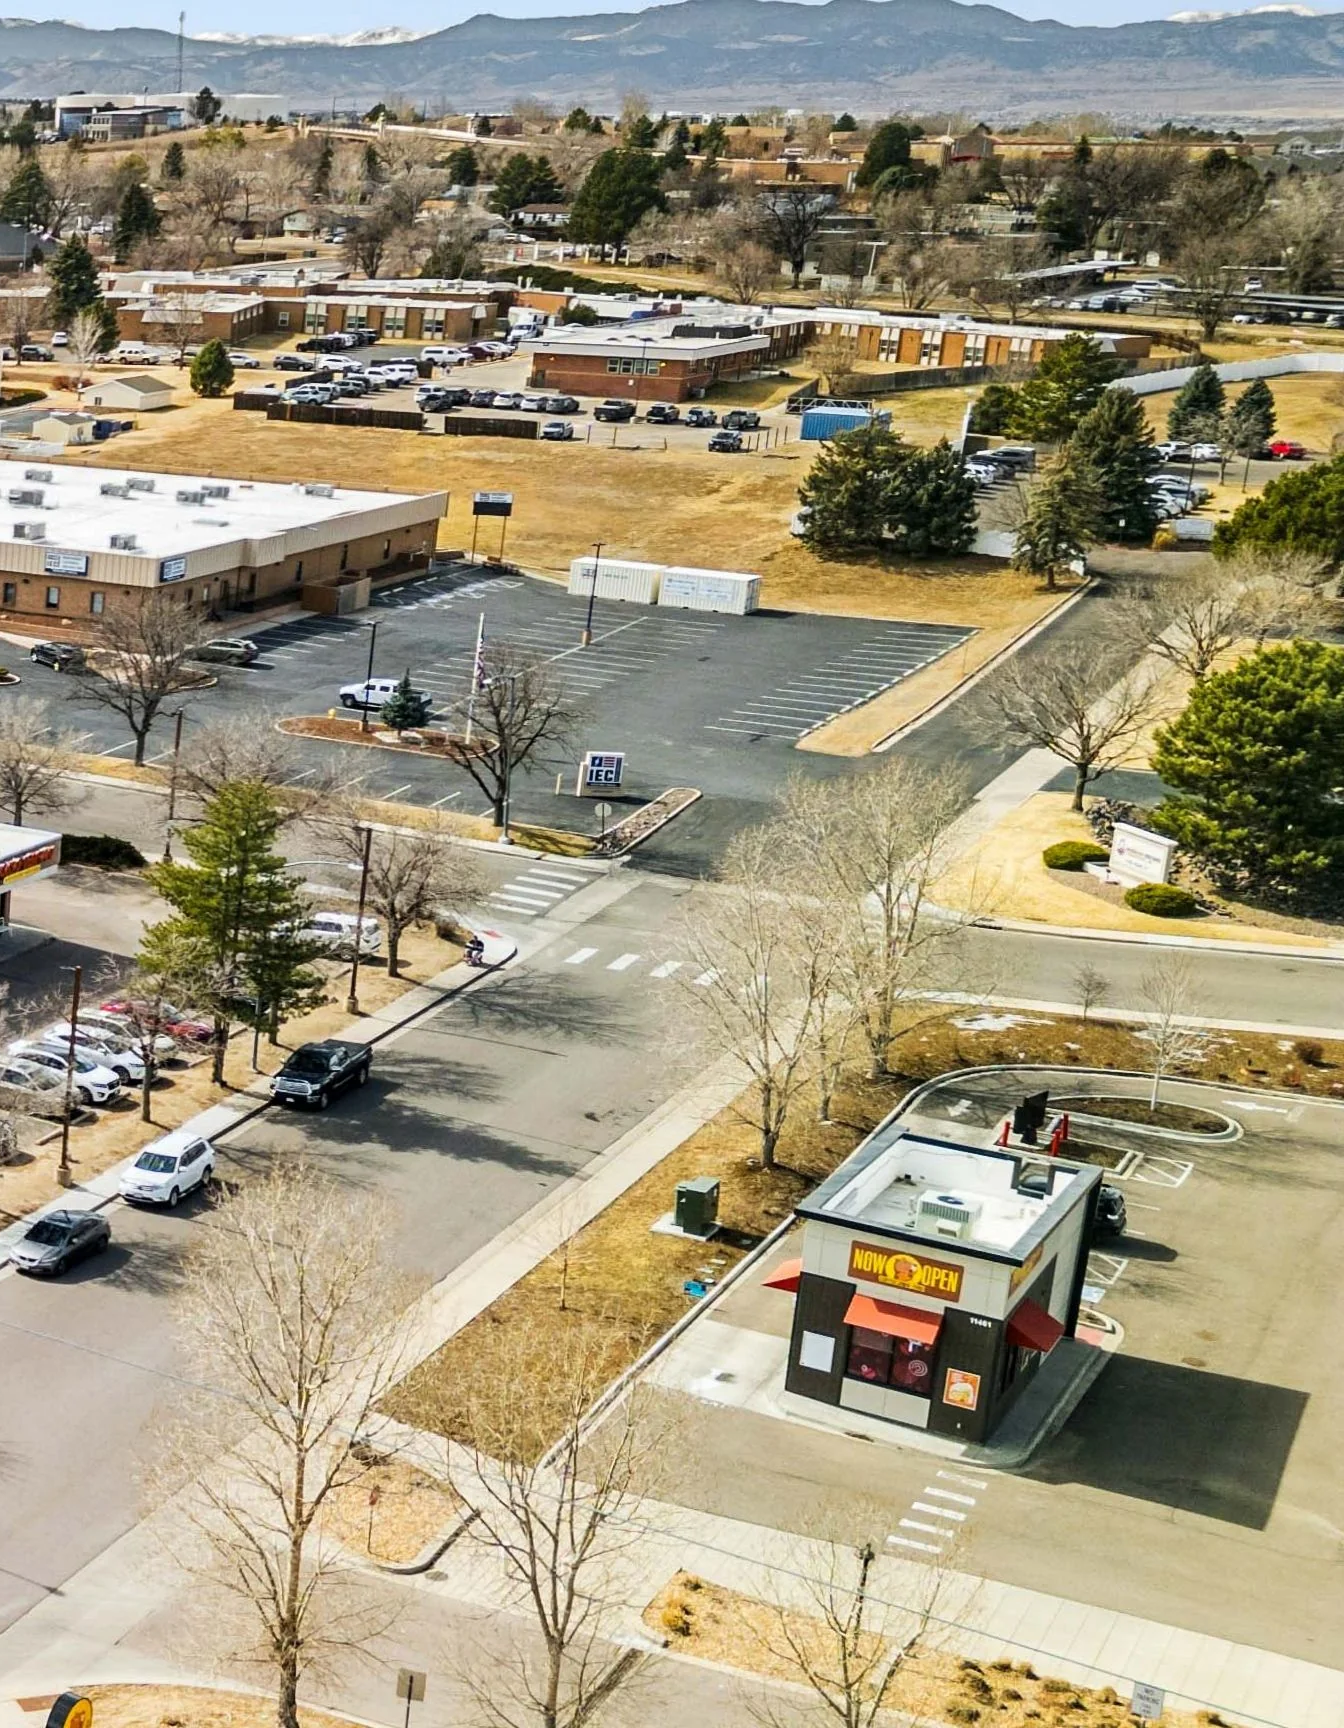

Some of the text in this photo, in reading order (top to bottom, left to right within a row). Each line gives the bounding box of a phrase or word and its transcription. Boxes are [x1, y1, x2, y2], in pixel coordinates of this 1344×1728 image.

[589, 769, 614, 782] IEC
[853, 1248, 887, 1275] NOW
[922, 1264, 960, 1293] OPEN
